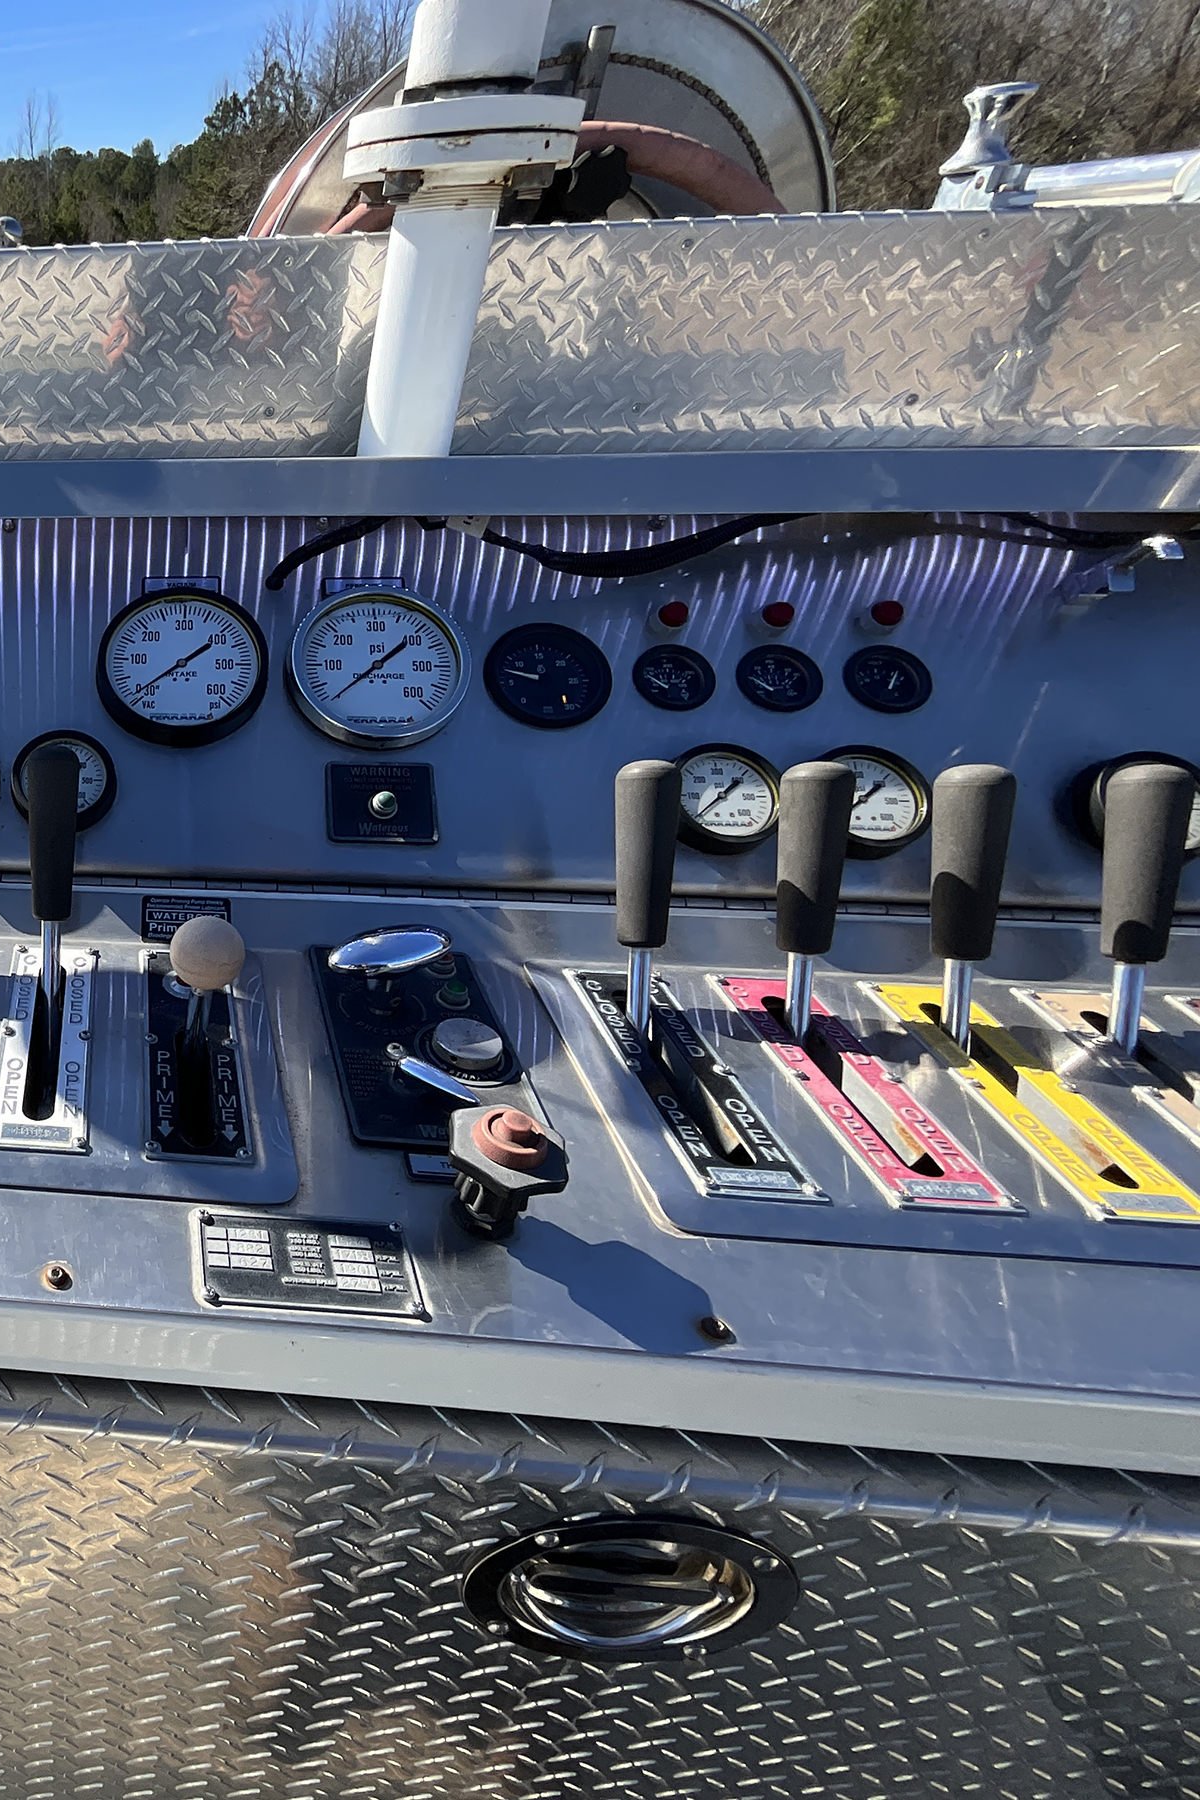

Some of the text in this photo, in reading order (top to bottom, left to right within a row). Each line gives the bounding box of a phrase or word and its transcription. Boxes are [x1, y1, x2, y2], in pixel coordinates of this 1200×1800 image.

[175, 620, 194, 631] 300
[366, 621, 386, 632] 300
[141, 631, 161, 642] 200
[208, 634, 227, 645] 400
[333, 634, 353, 646] 200
[402, 635, 422, 646] 400
[369, 642, 385, 655] psi
[130, 653, 147, 665] 100
[215, 659, 234, 670] 500
[324, 659, 342, 671] 100
[412, 660, 432, 672] 500
[207, 684, 226, 695] 600
[403, 686, 423, 698] 600
[142, 700, 156, 709] VAC
[209, 701, 221, 711] psi
[350, 766, 411, 777] WARNING
[710, 767, 724, 776] 300
[81, 776, 93, 785] 500
[692, 776, 706, 784] 200
[714, 781, 725, 790] psi
[686, 792, 700, 800] 100
[742, 792, 756, 801] 500
[885, 797, 899, 805] 500
[737, 808, 751, 817] 600
[358, 822, 409, 836] Waterous
[13, 954, 38, 1022] CLOSED
[69, 957, 88, 1026] CLOSED
[585, 979, 642, 1055] CLOSED
[355, 1020, 423, 1037] PRESSURE
[345, 1058, 382, 1066] SLIGHTLY
[449, 1068, 499, 1082] STRAINER
[0, 1057, 25, 1117] OPEN
[63, 1060, 82, 1119] OPEN
[156, 1050, 175, 1118] PRIME
[217, 1054, 237, 1123] PRIME
[657, 1094, 713, 1159] OPEN
[724, 1097, 788, 1164] OPEN
[828, 1102, 902, 1170] OPEN
[903, 1106, 978, 1174] OPEN
[1013, 1112, 1098, 1183] OPEN
[1084, 1116, 1176, 1188] OPEN
[240, 1257, 268, 1267] 627
